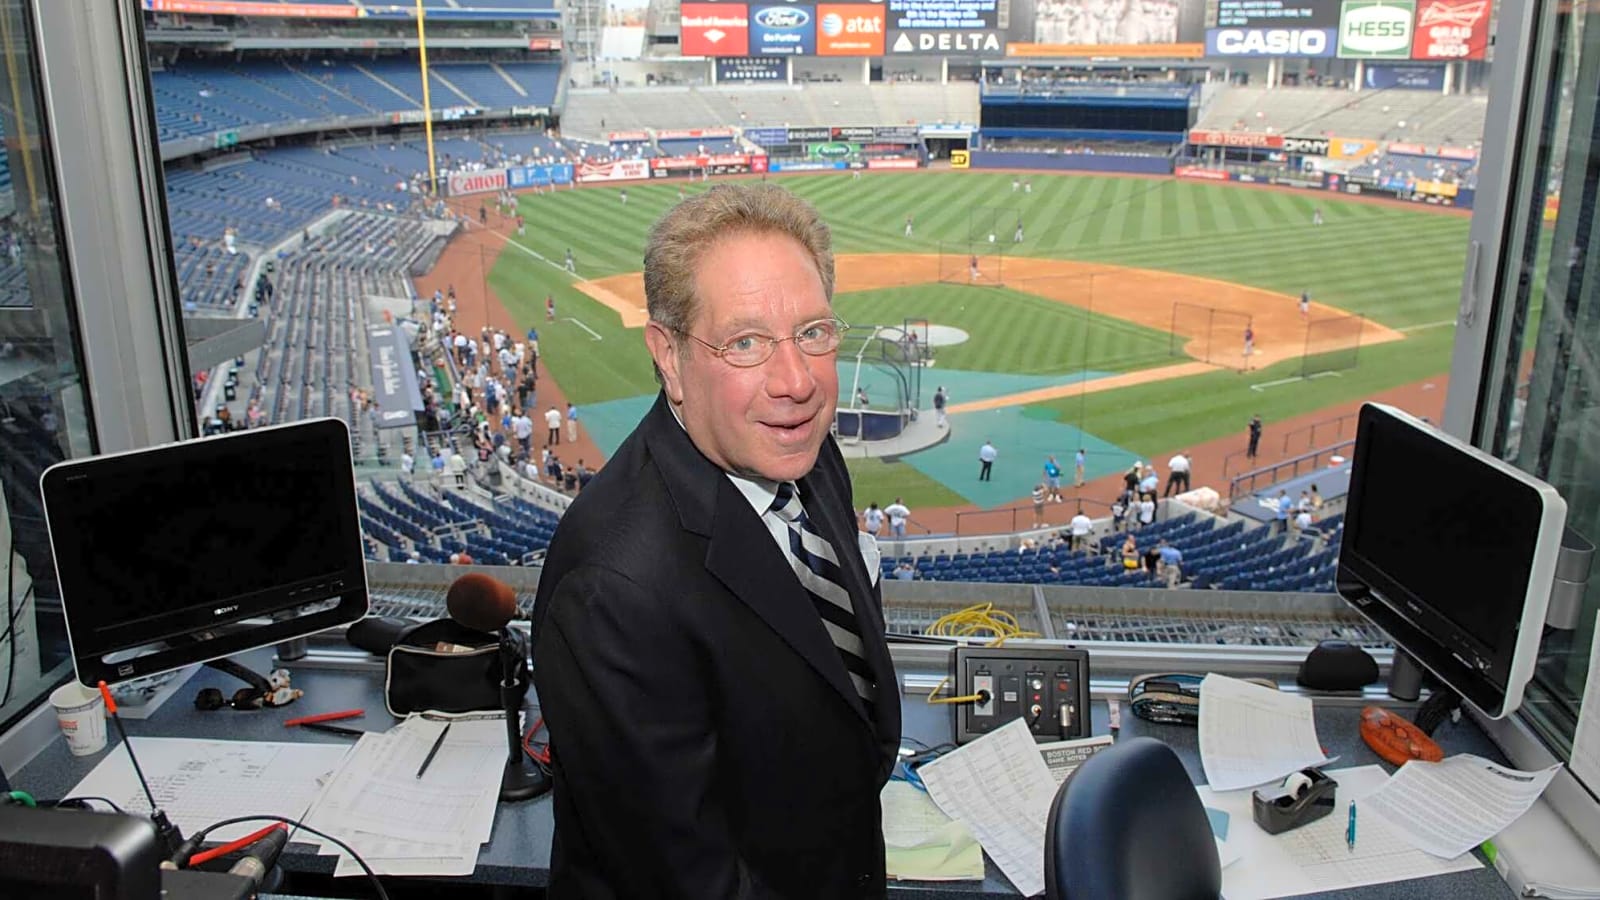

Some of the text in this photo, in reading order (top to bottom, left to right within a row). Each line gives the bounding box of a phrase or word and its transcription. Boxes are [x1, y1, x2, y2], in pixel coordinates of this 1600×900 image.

[681, 16, 703, 27] Bank
[713, 16, 748, 27] America
[1349, 21, 1405, 37] HESS
[919, 33, 1000, 51] DELTA
[1217, 29, 1327, 54] CASIO
[1224, 134, 1268, 146] TOYOTA
[1284, 139, 1328, 154] DKNY
[451, 174, 505, 194] Canon
[1046, 750, 1076, 758] BOSTON
